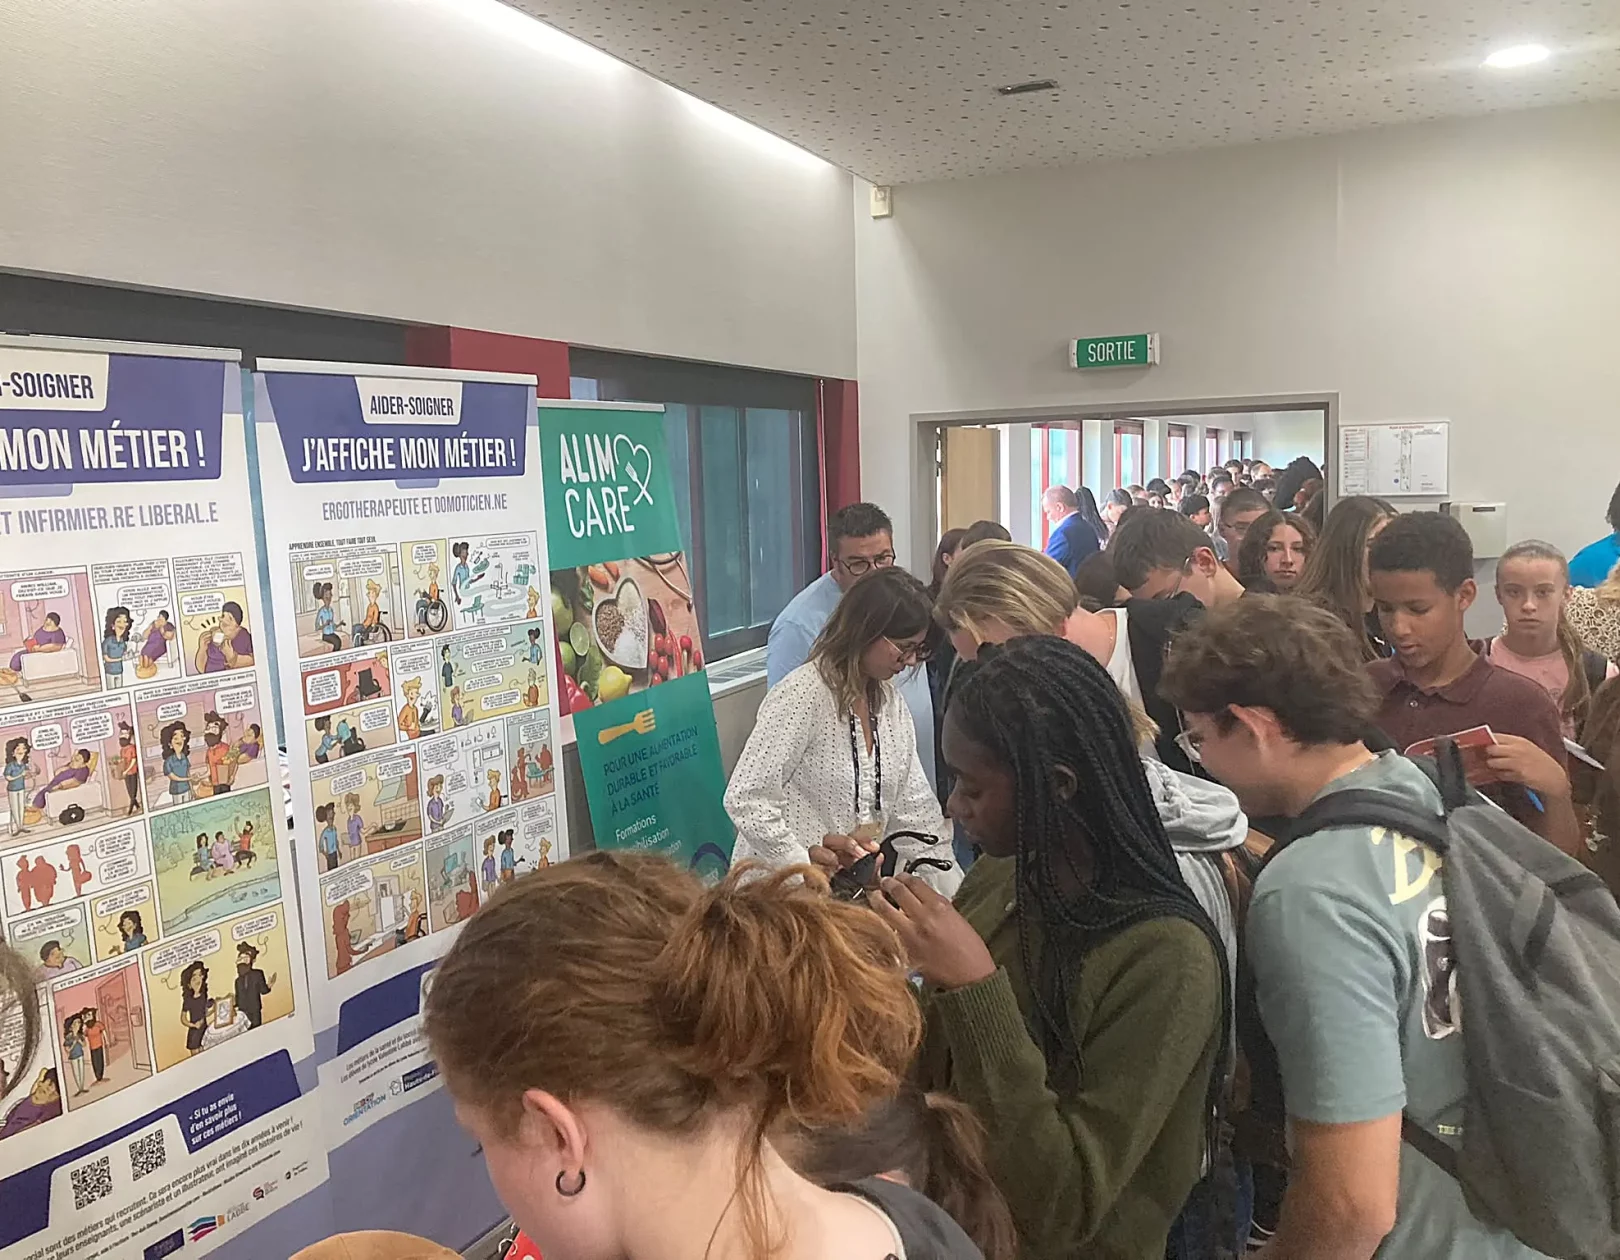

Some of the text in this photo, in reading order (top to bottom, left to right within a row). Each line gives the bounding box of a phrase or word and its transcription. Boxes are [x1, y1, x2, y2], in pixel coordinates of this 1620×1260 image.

[1088, 340, 1136, 362] SORTIE
[0, 372, 94, 399] -SOIGNER
[370, 395, 455, 416] AIDER-SOIGNER
[0, 420, 206, 471] MON MÉTIER !
[302, 431, 517, 472] J'AFFICHE MON MÉTIER !
[560, 432, 616, 485] ALIM
[18, 505, 134, 534] INFIRMIER.RE
[139, 502, 219, 527] LIBERAL.E
[322, 493, 508, 521] ERGOTHERAPEUTE ET DOMOTICIEN.NE
[565, 486, 635, 538] CARE
[289, 541, 314, 550] APPRENDRE
[603, 756, 628, 776] POUR
[628, 748, 648, 766] UNE
[607, 767, 647, 796] DURABLE
[648, 761, 659, 777] ET
[618, 799, 630, 812] LA
[616, 814, 656, 844] Formations
[202, 1104, 209, 1115] tu
[210, 1102, 217, 1112] as
[218, 1092, 234, 1108] envie
[205, 1112, 223, 1127] savoir
[224, 1103, 237, 1120] plus
[344, 1094, 386, 1126] ORIENTATION
[191, 1134, 202, 1145] sur
[203, 1128, 214, 1139] ces
[215, 1114, 238, 1132] métiers
[45, 1240, 61, 1254] sont
[63, 1235, 76, 1246] des
[77, 1220, 103, 1239] métiers
[104, 1212, 115, 1226] qui
[171, 1172, 192, 1188] encore
[193, 1164, 206, 1178] plus
[206, 1158, 217, 1169] vrai
[218, 1150, 231, 1162] dans
[232, 1145, 240, 1154] les
[242, 1140, 250, 1150] dix
[251, 1129, 270, 1144] années
[276, 1117, 290, 1130] venir
[119, 1216, 132, 1228] une
[133, 1198, 165, 1221] scénariste
[166, 1192, 173, 1202] et
[174, 1188, 182, 1198] un
[215, 1162, 225, 1174] ont
[226, 1150, 247, 1168] imaginé
[248, 1145, 258, 1156] ces
[259, 1132, 283, 1150] histoires
[283, 1128, 291, 1137] de
